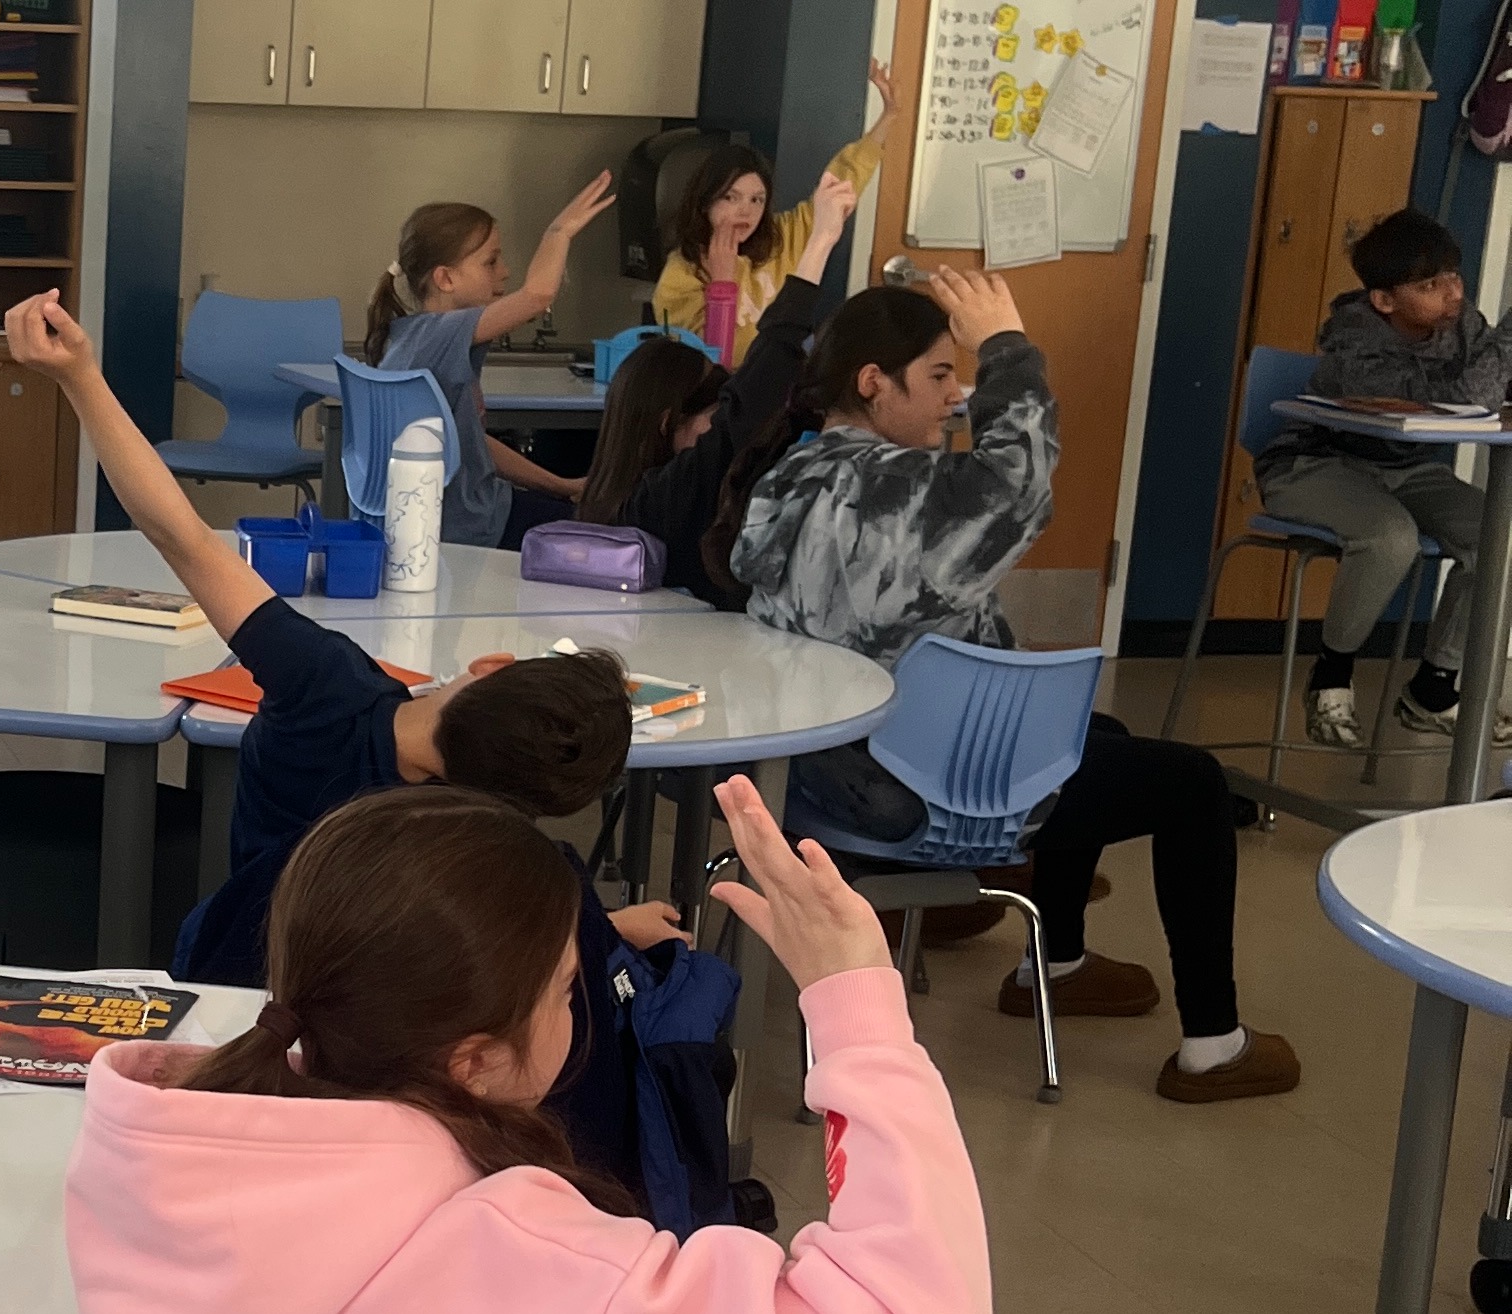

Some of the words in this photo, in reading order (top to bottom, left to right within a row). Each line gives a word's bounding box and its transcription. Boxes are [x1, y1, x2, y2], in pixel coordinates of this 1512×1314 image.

[39, 993, 96, 1006] GET?
[99, 998, 172, 1013] YOU
[37, 1008, 168, 1028] CLOSE
[73, 1006, 142, 1018] WOULD
[97, 1025, 148, 1036] HOW
